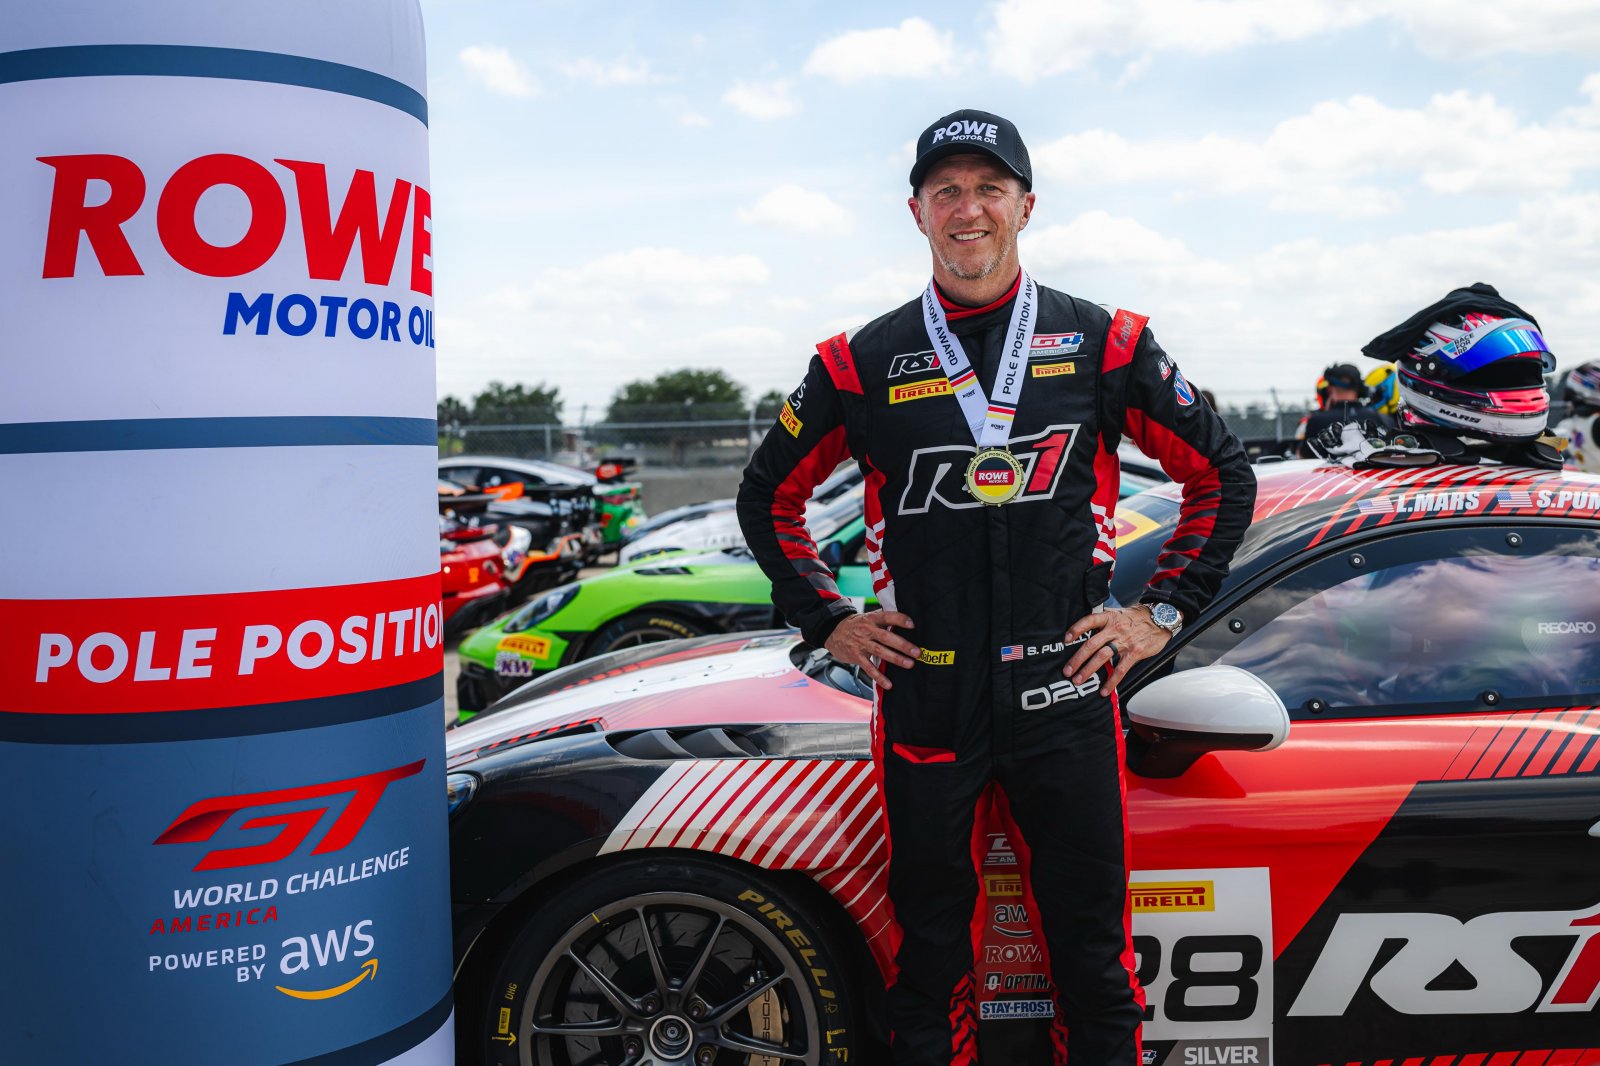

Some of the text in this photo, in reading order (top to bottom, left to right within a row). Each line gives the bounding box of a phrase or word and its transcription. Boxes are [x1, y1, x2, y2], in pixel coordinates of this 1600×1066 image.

[932, 120, 998, 144] ROWE
[36, 153, 432, 297] ROWE
[223, 292, 434, 348] MOTOR OIL
[935, 326, 958, 366] AWARD
[1002, 362, 1018, 394] POLE
[1012, 302, 1030, 358] POSITION
[1454, 332, 1474, 345] RACE
[1456, 340, 1470, 349] FOR
[1036, 365, 1071, 375] PIRELLI
[895, 380, 948, 400] PIRELLI
[1439, 408, 1481, 423] MARS
[979, 472, 1009, 480] ROWE
[1396, 491, 1480, 512] L.MARS
[1538, 621, 1596, 634] RECARO
[35, 628, 218, 684] POLE
[1027, 646, 1039, 656] S.
[501, 659, 533, 673] KW
[152, 758, 426, 872] GT
[174, 847, 410, 909] WORLD CHALLENGE
[1131, 887, 1205, 907] IRELLI
[149, 906, 279, 935] AMERICA
[995, 904, 1028, 923] aw
[149, 920, 375, 974] POWERED aws
[738, 890, 836, 999] PIRELLI
[985, 945, 1041, 963] ROW
[236, 963, 266, 983] BY
[1004, 974, 1051, 990] OPTIM
[504, 982, 518, 1000] DHG
[982, 1002, 1053, 1013] STAY-FROST
[1184, 1046, 1259, 1065] SILVER
